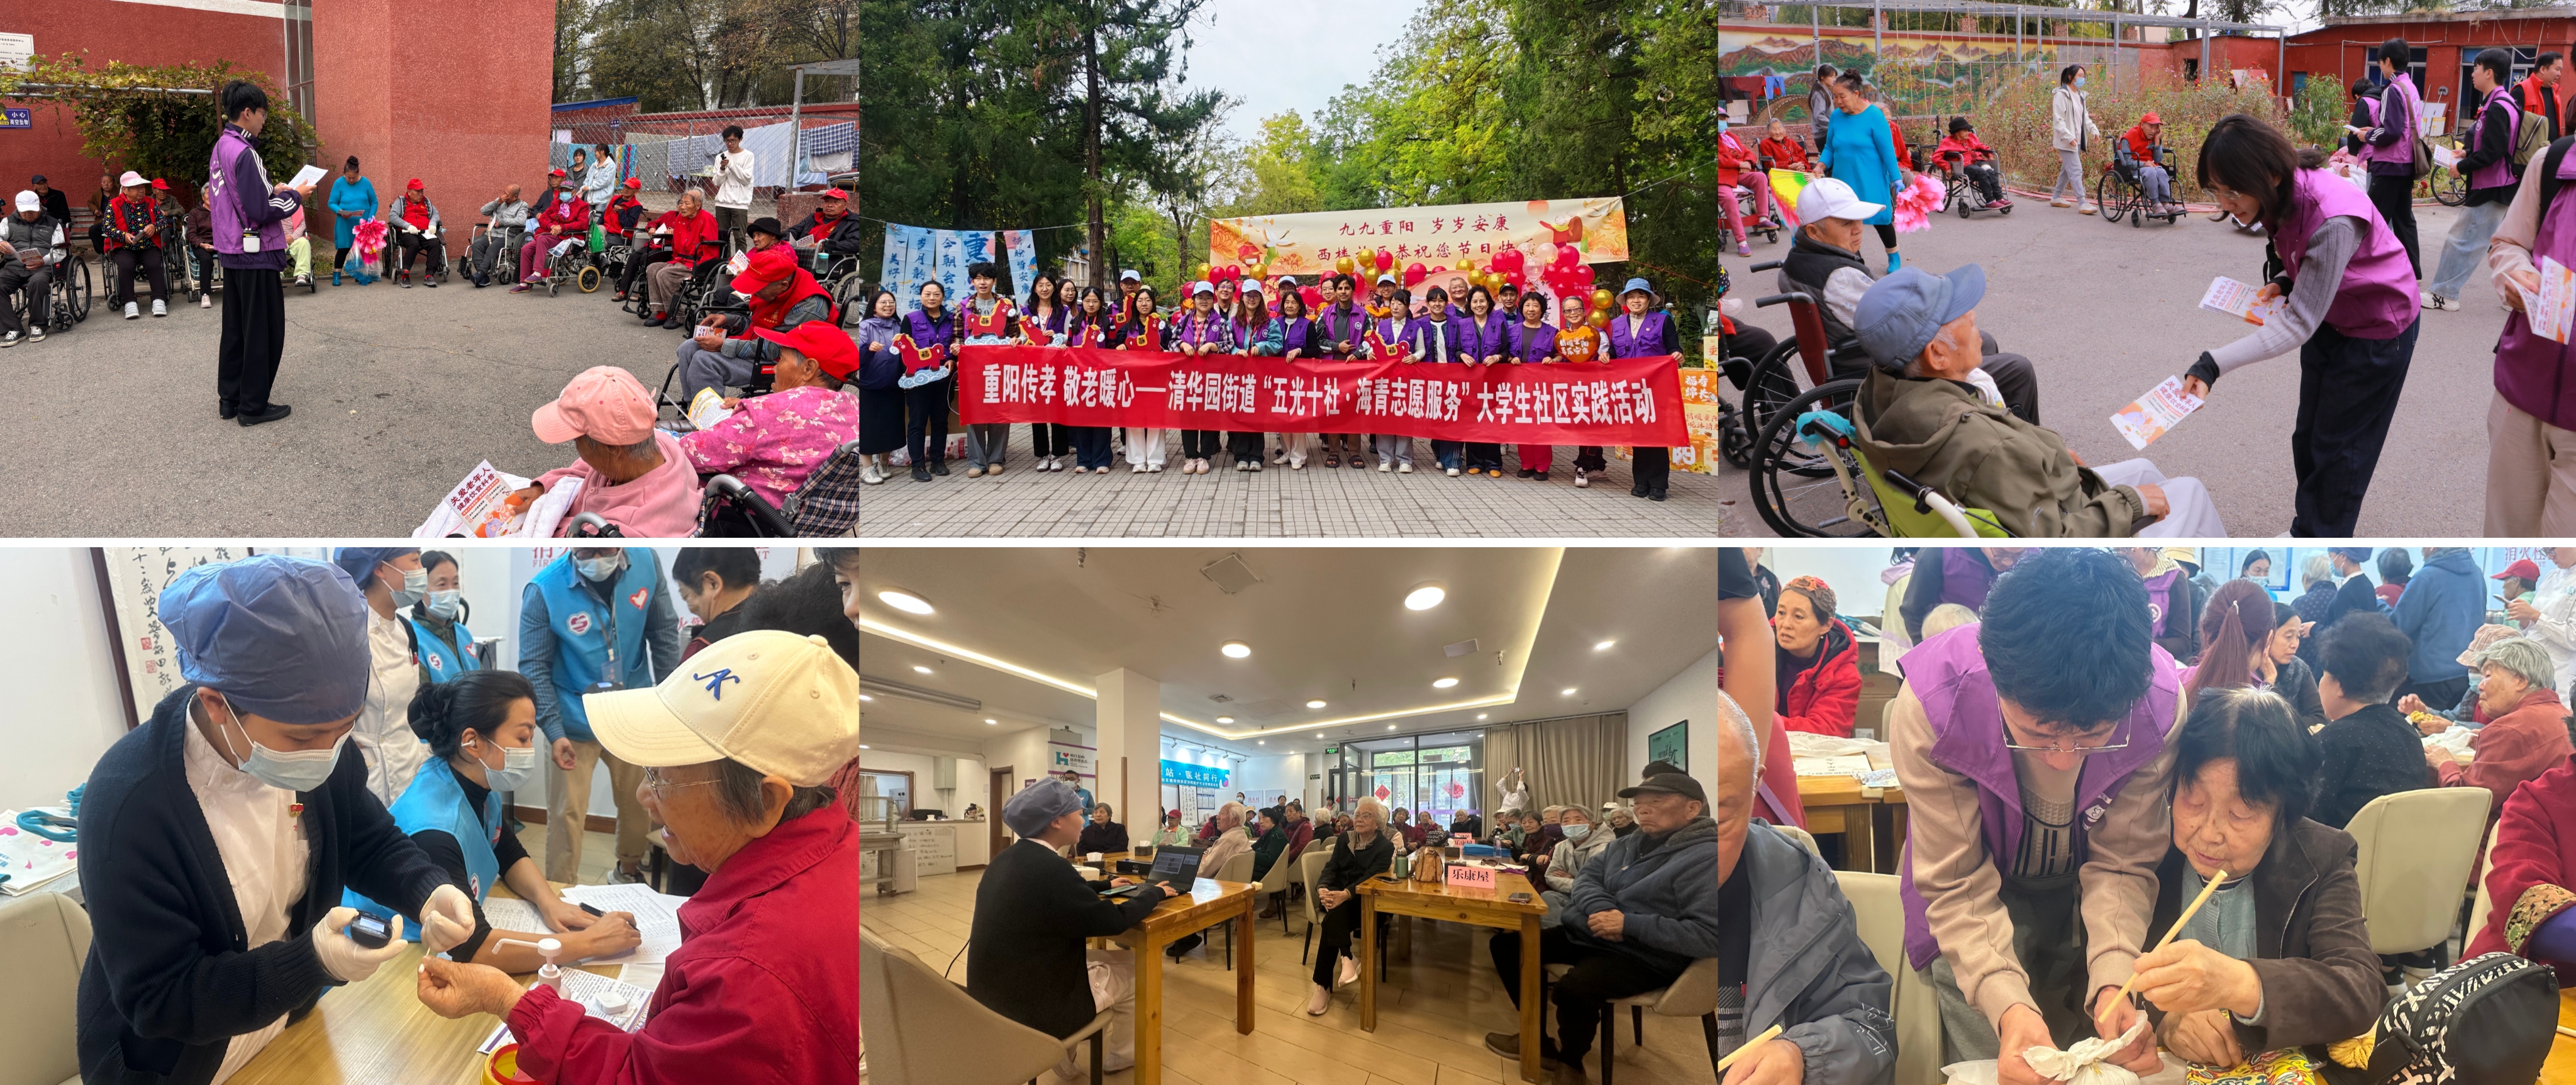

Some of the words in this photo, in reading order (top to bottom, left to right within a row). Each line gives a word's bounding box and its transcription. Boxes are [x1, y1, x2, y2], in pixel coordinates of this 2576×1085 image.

[1340, 220, 1413, 236] 九九重阳
[1431, 214, 1509, 235] 岁岁安康
[983, 363, 1057, 404] 重阳传孝
[1685, 374, 1709, 387] 福寿
[451, 467, 491, 506] 关爱老年人
[457, 473, 495, 511] 健康饮食科普
[1452, 869, 1489, 882] 乐康屋
